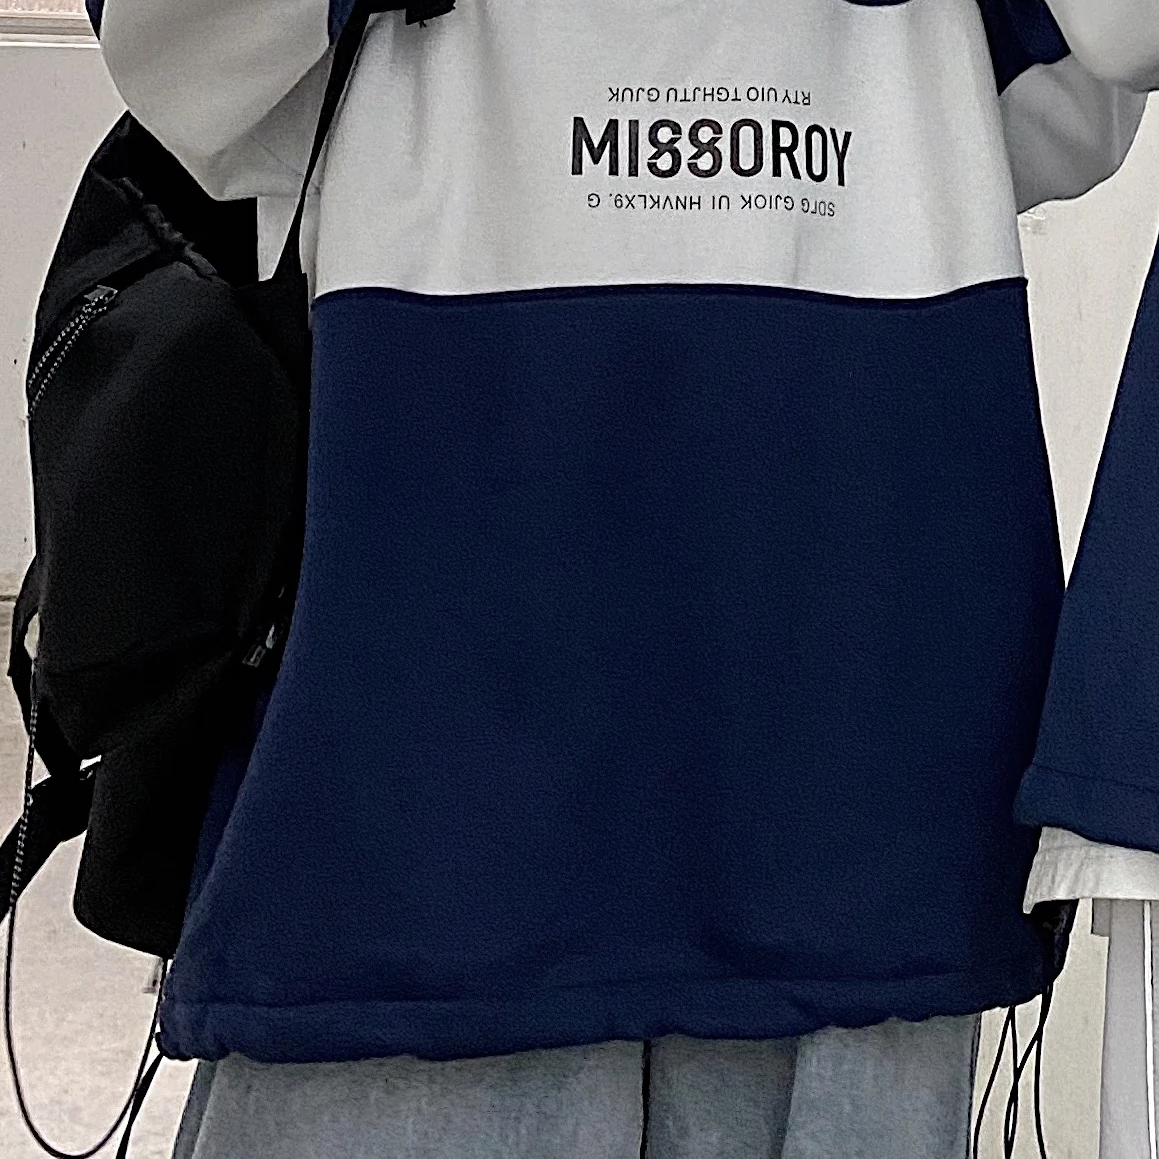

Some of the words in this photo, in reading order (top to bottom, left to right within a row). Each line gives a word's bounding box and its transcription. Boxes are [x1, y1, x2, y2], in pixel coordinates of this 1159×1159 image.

[608, 87, 660, 103] GJUK
[666, 86, 742, 103] TGHJTU
[746, 86, 778, 103] UIO
[781, 89, 811, 106] RTY
[587, 192, 601, 209] G
[711, 194, 730, 210] UI
[740, 194, 795, 211] GJIOK
